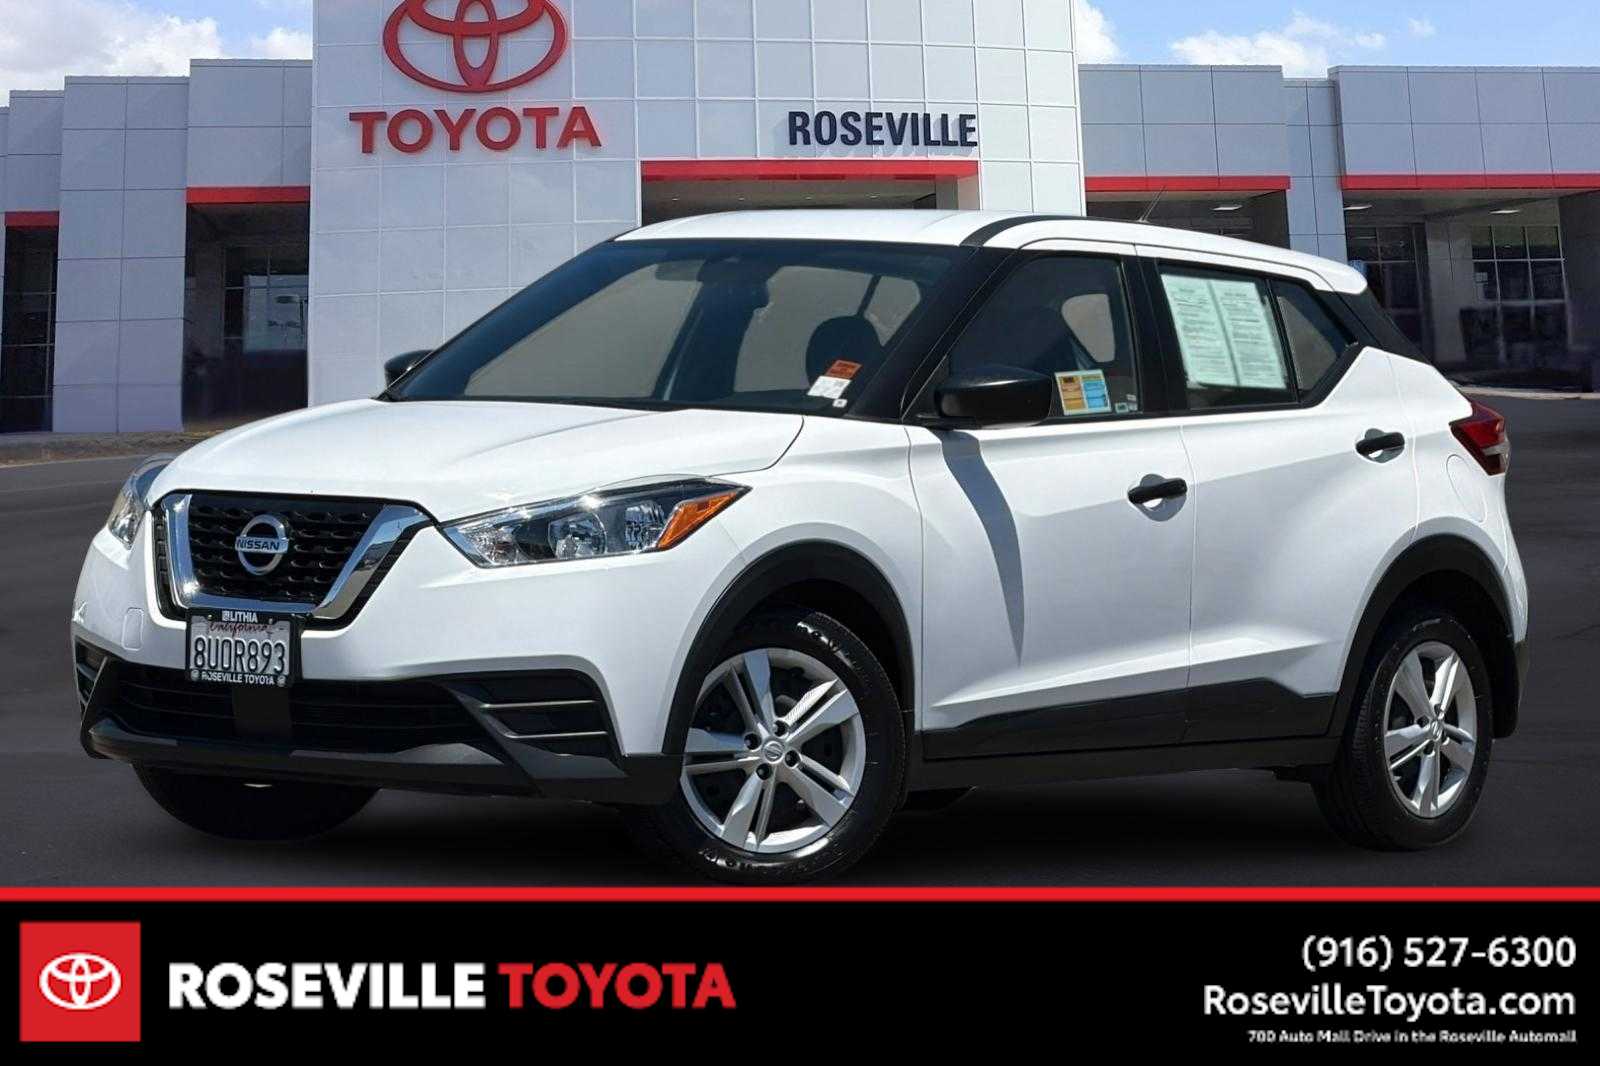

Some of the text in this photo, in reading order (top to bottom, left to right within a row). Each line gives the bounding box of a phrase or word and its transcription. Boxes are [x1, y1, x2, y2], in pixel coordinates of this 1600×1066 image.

[350, 106, 603, 154] TOYOTA
[788, 111, 979, 148] ROSEVILLE
[236, 539, 280, 551] NISSAN
[230, 611, 258, 623] LITHIA
[201, 671, 275, 685] ROSEVILLE TOYOTA
